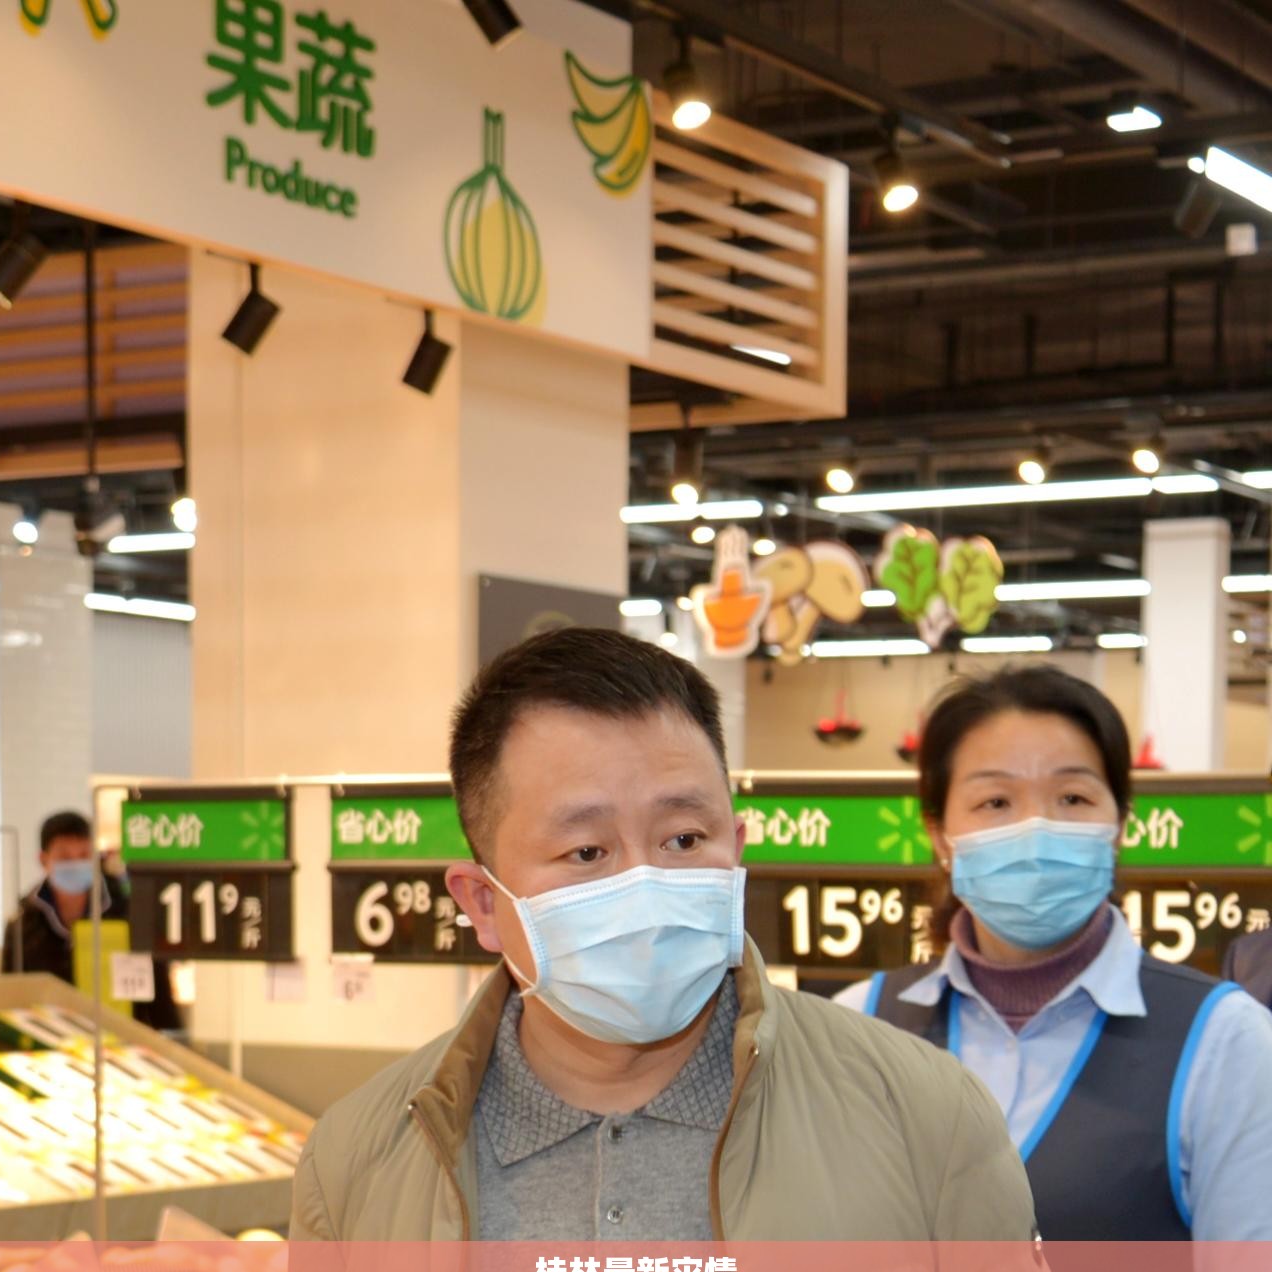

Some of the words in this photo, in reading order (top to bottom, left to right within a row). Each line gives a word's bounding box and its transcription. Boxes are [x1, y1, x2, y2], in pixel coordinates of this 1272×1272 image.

[206, 0, 376, 158] 果蔬
[224, 136, 357, 218] Produce
[126, 811, 205, 849] 省心价
[336, 808, 422, 845] 省心价
